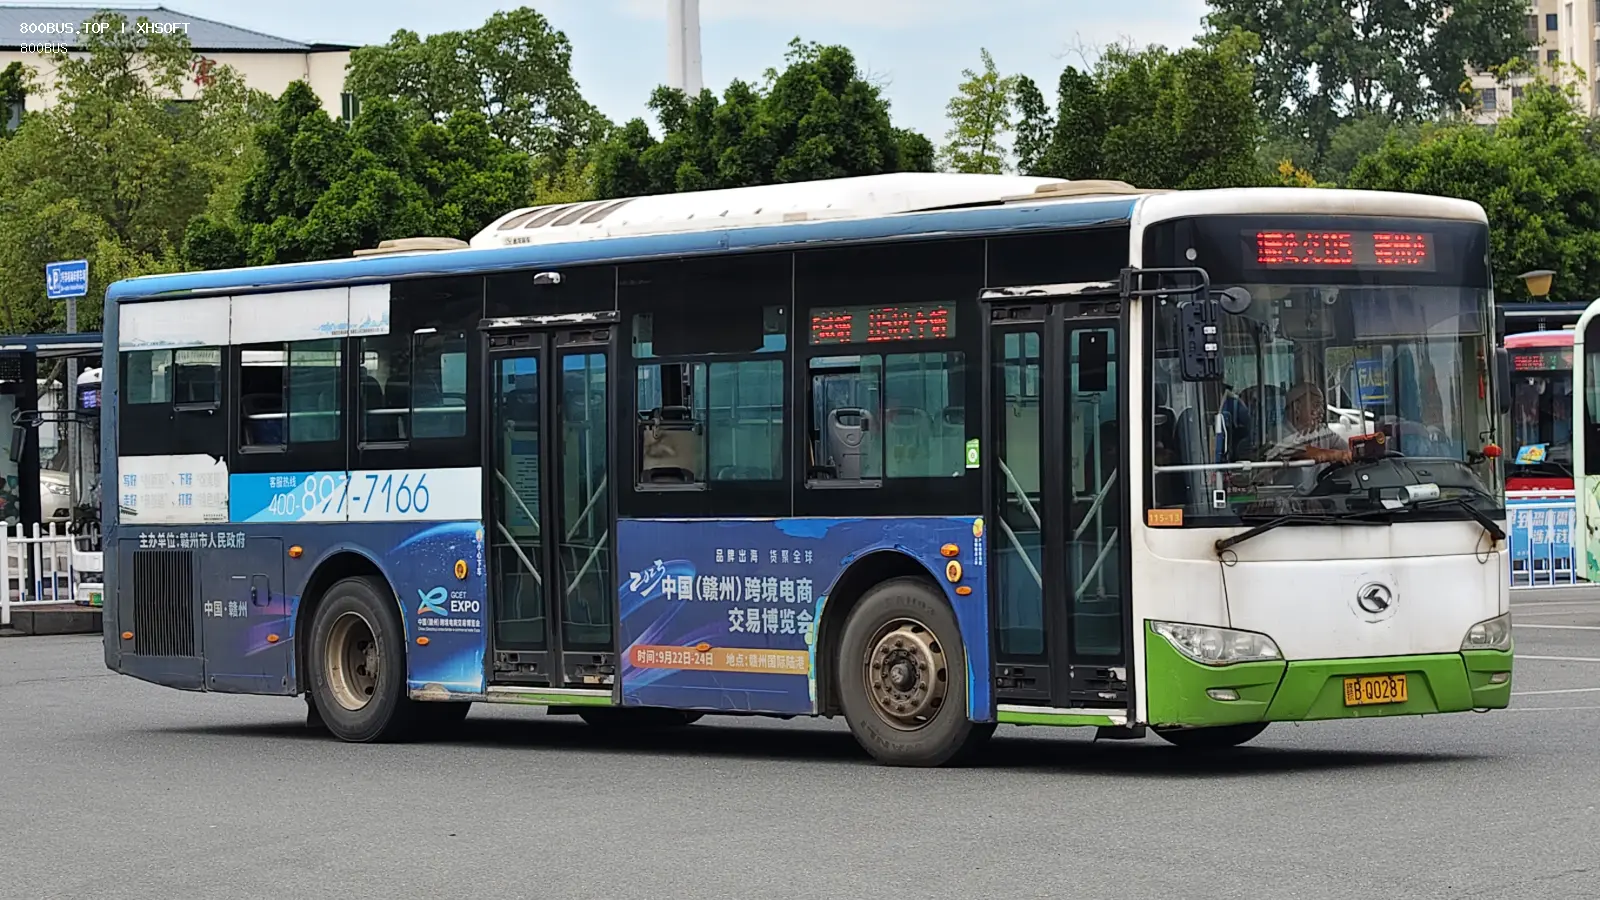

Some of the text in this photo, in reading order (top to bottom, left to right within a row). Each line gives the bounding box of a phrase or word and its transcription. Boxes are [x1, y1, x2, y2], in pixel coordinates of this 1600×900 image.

[269, 476, 297, 488] 客服热线
[268, 473, 430, 516] 400-897-7166
[715, 549, 814, 564] 品牌出海 货聚全球
[450, 600, 480, 613] EXPO
[728, 607, 813, 635] 交易博览会
